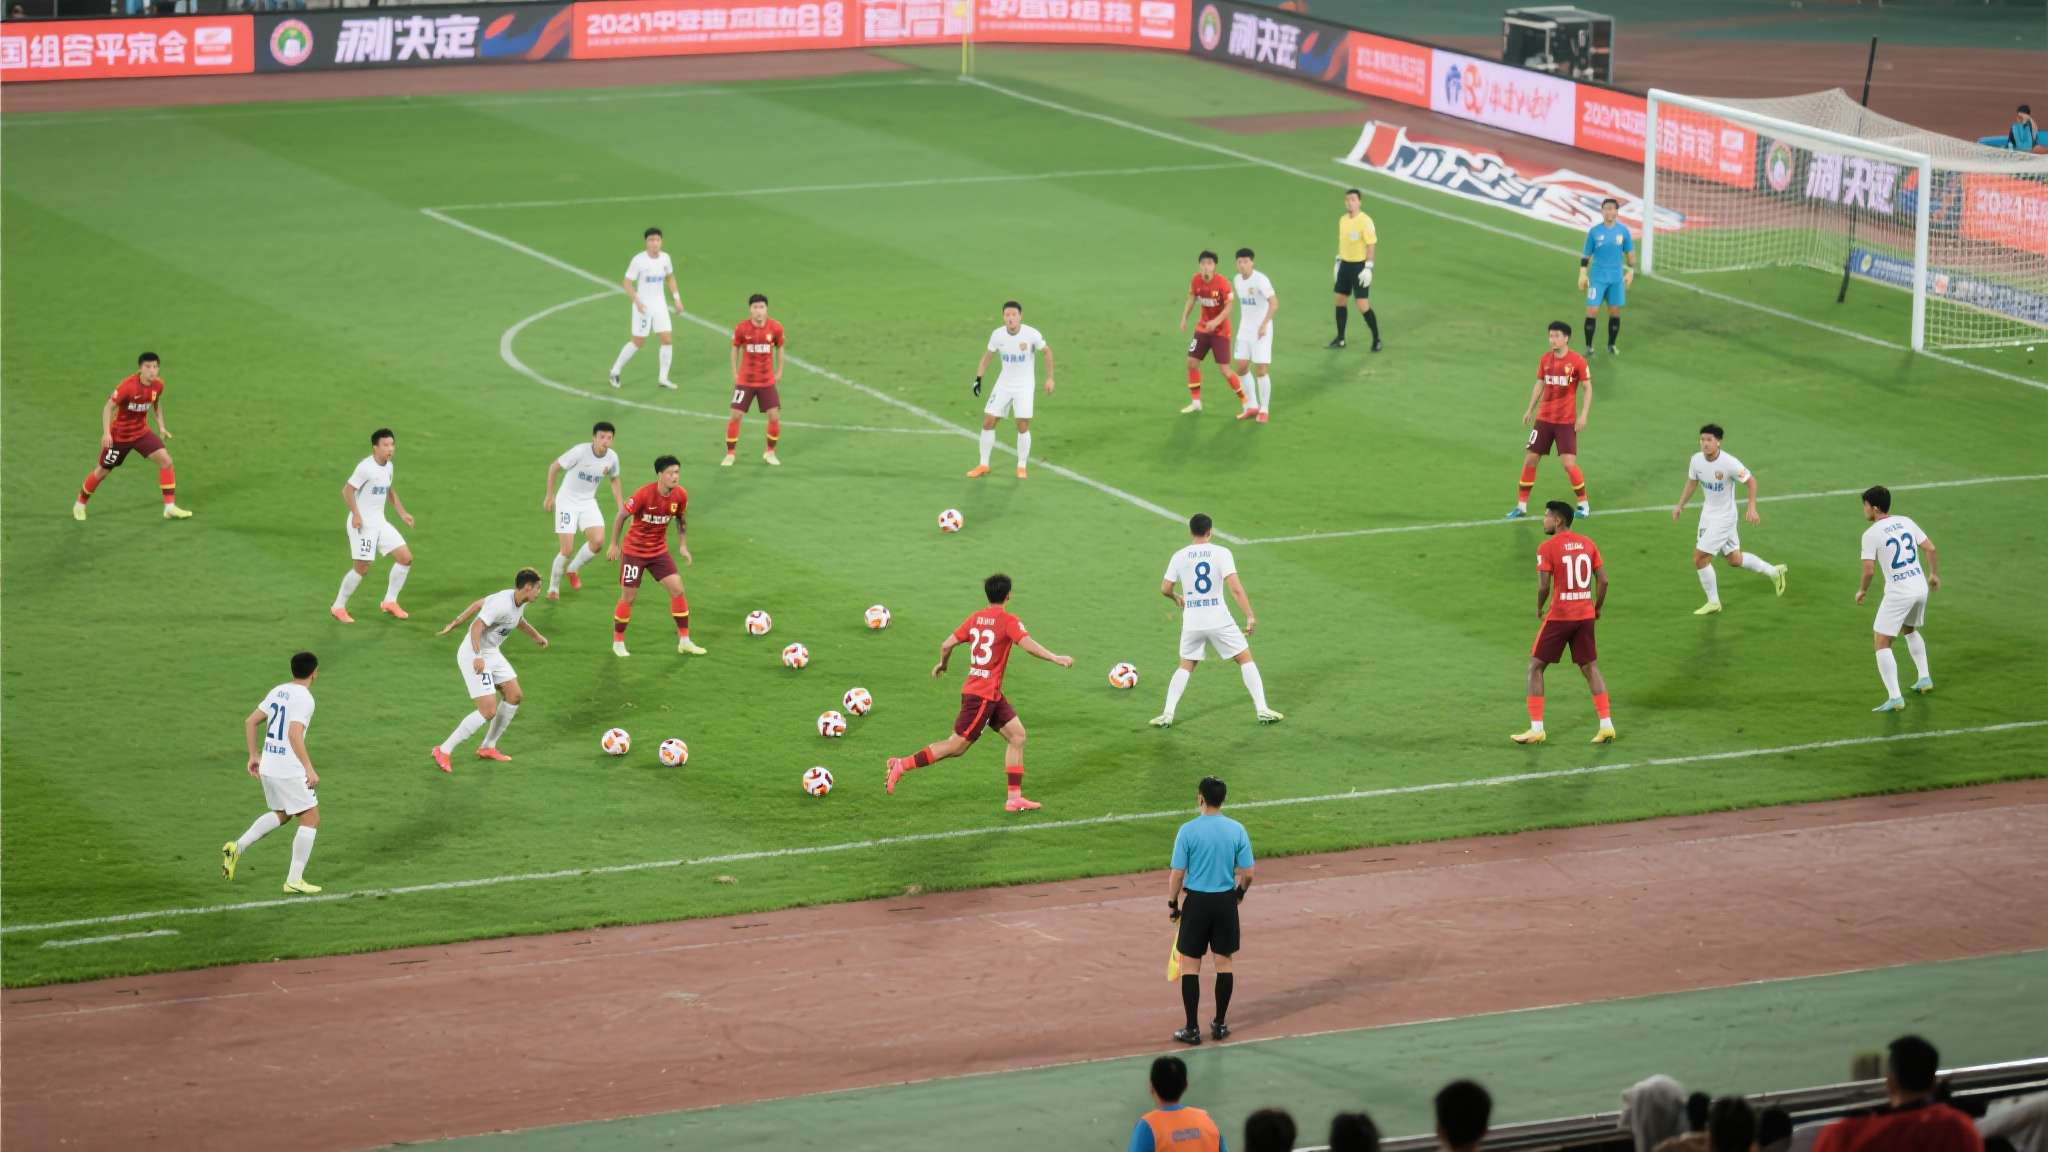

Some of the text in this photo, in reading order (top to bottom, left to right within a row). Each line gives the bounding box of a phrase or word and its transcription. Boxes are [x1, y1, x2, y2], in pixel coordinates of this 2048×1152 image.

[1886, 532, 1916, 569] 23
[1194, 561, 1212, 594] 8
[1562, 553, 1592, 590] 10
[969, 627, 995, 666] 23
[266, 702, 286, 741] 21
